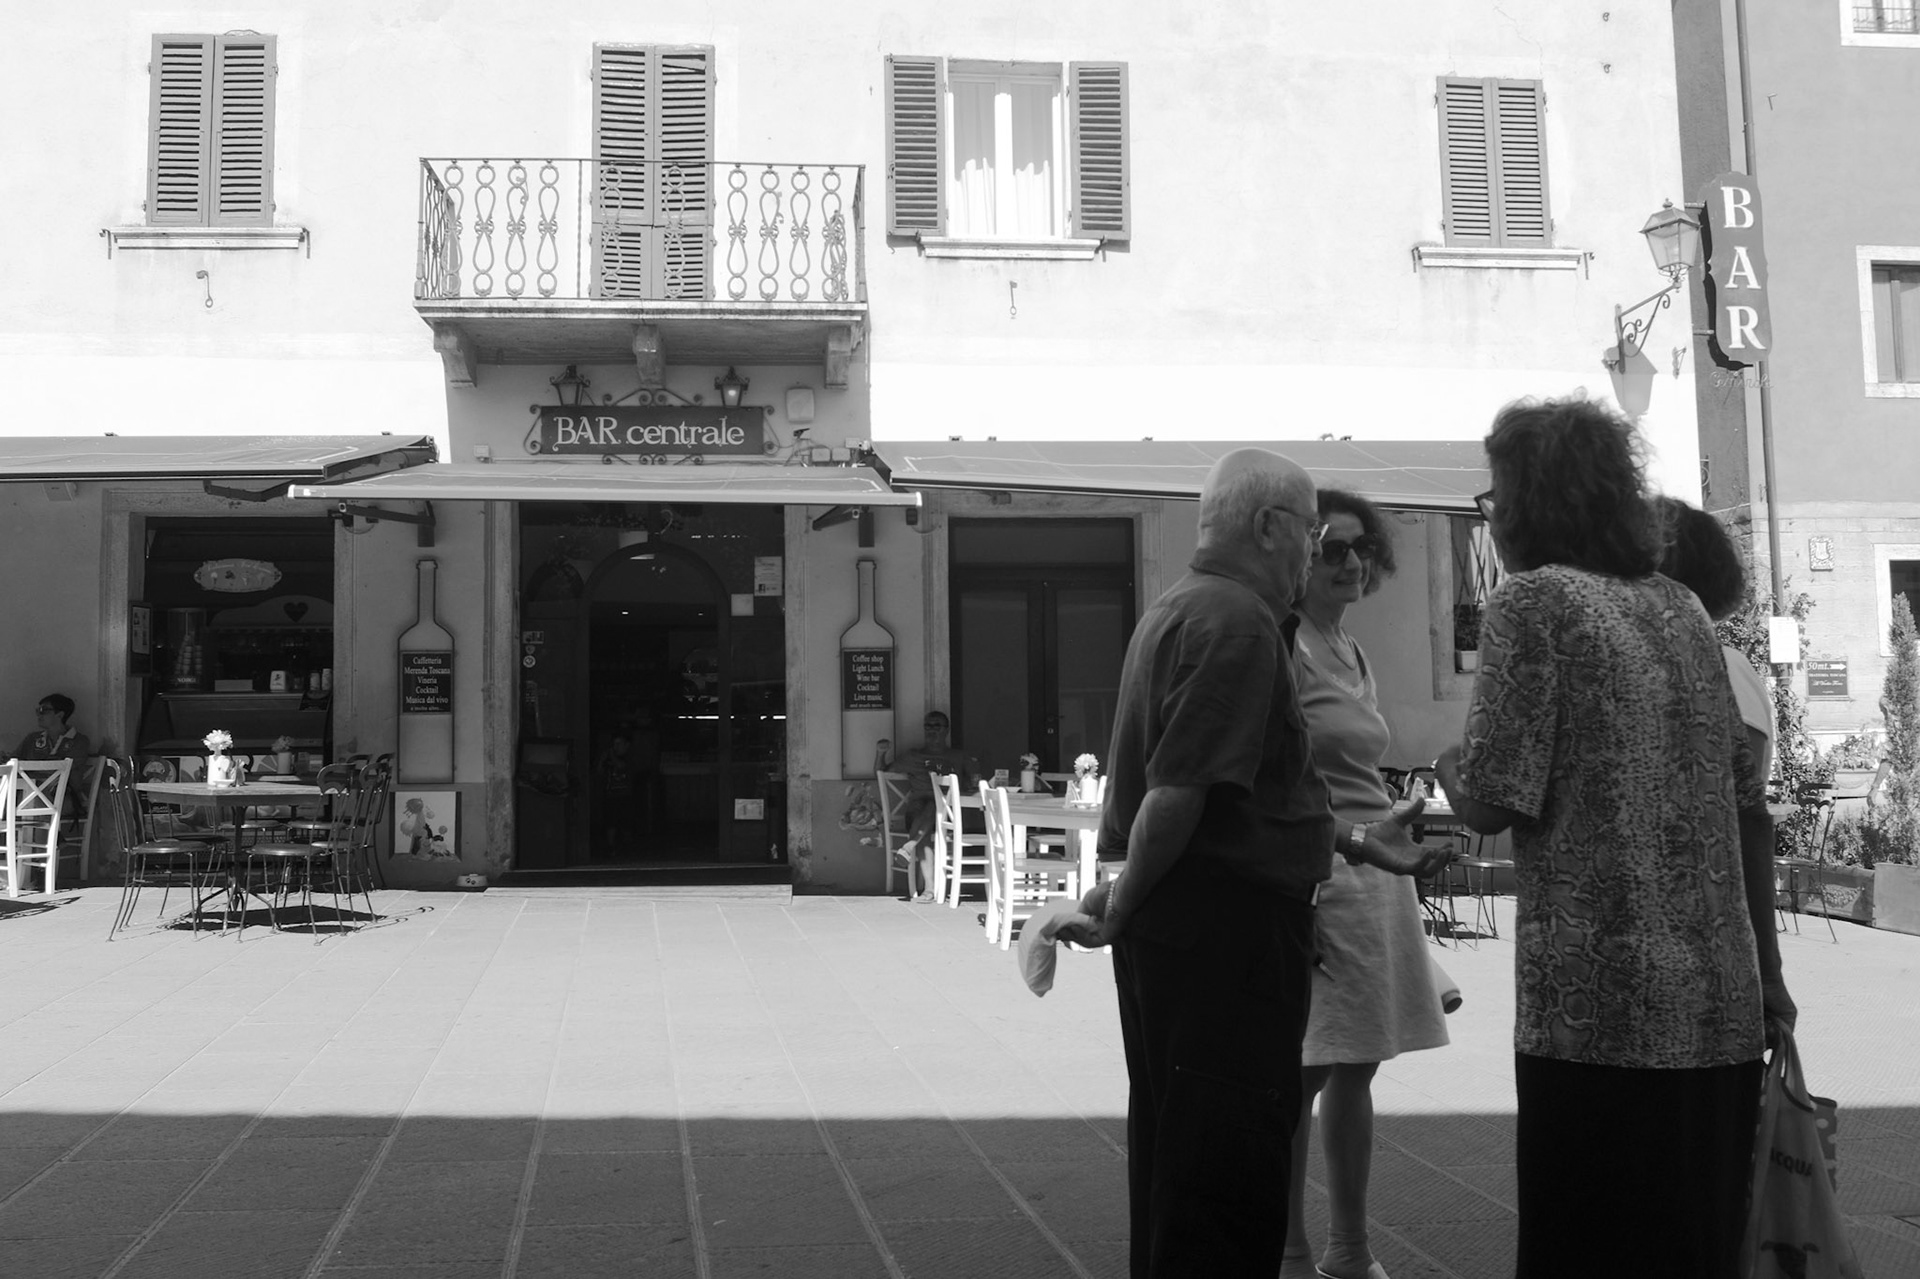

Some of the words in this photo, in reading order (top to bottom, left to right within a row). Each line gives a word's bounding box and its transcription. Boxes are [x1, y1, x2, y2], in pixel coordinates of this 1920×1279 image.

[1720, 186, 1766, 350] BAR
[552, 416, 622, 452] BAR
[626, 415, 745, 448] centrale
[412, 656, 442, 664] Caffetteria
[852, 654, 870, 662] Coffee
[871, 655, 884, 665] shop
[404, 666, 428, 674] Merenda
[429, 666, 451, 674] Toscana
[852, 664, 866, 673] Light
[867, 664, 884, 672] Lunch
